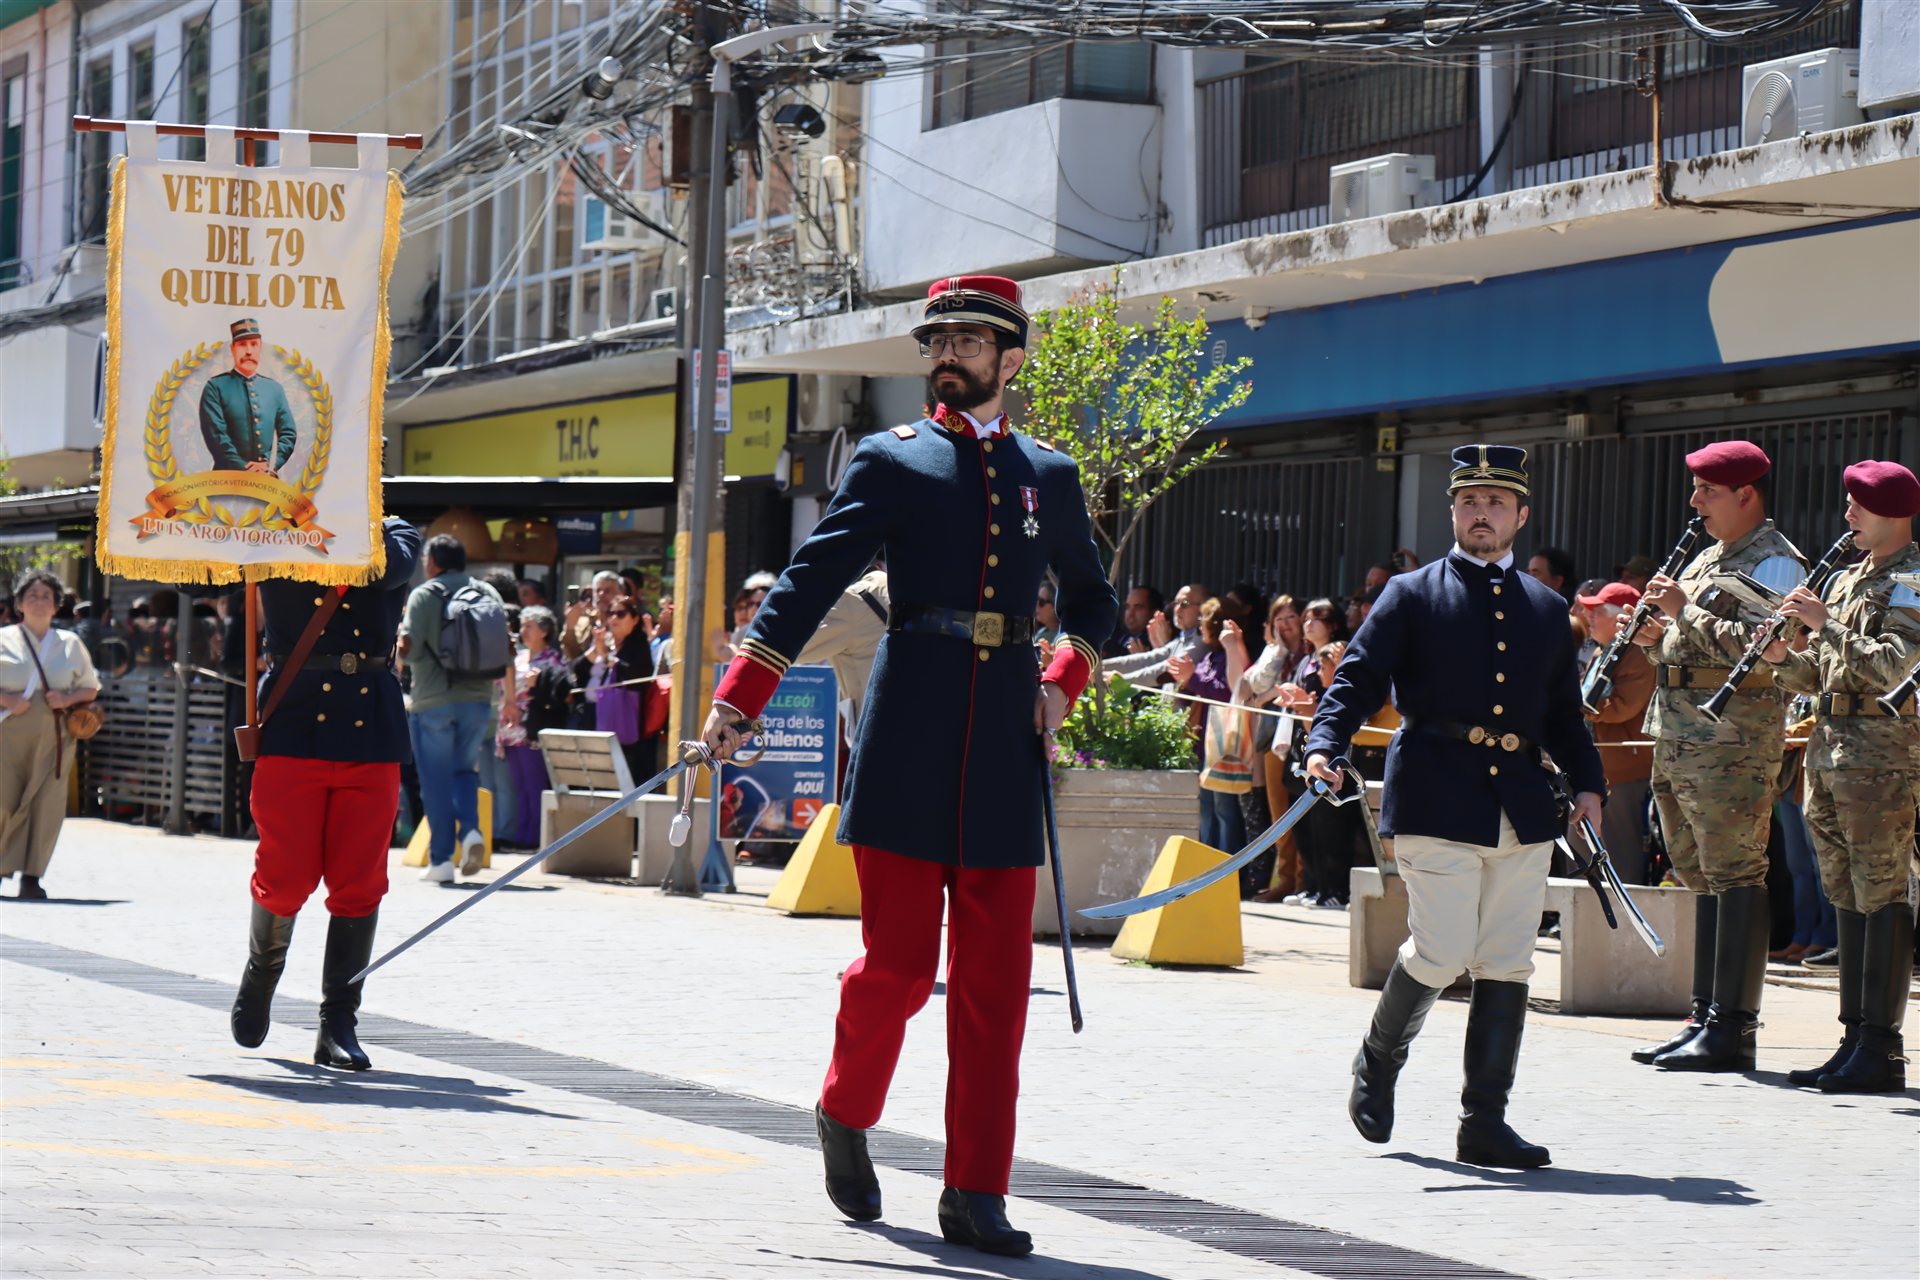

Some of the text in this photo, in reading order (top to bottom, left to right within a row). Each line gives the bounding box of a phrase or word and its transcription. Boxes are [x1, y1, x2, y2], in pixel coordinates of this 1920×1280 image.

[162, 173, 346, 222] VETERANOS
[206, 224, 305, 267] DEL 79
[160, 267, 346, 311] QUILLOTA
[229, 479, 267, 491] VETERANOS
[144, 518, 322, 545] LUIS ARO MORGADO
[787, 715, 804, 729] de
[805, 715, 825, 730] los
[753, 729, 824, 748] chilenos
[793, 779, 825, 795] AQUÍ
